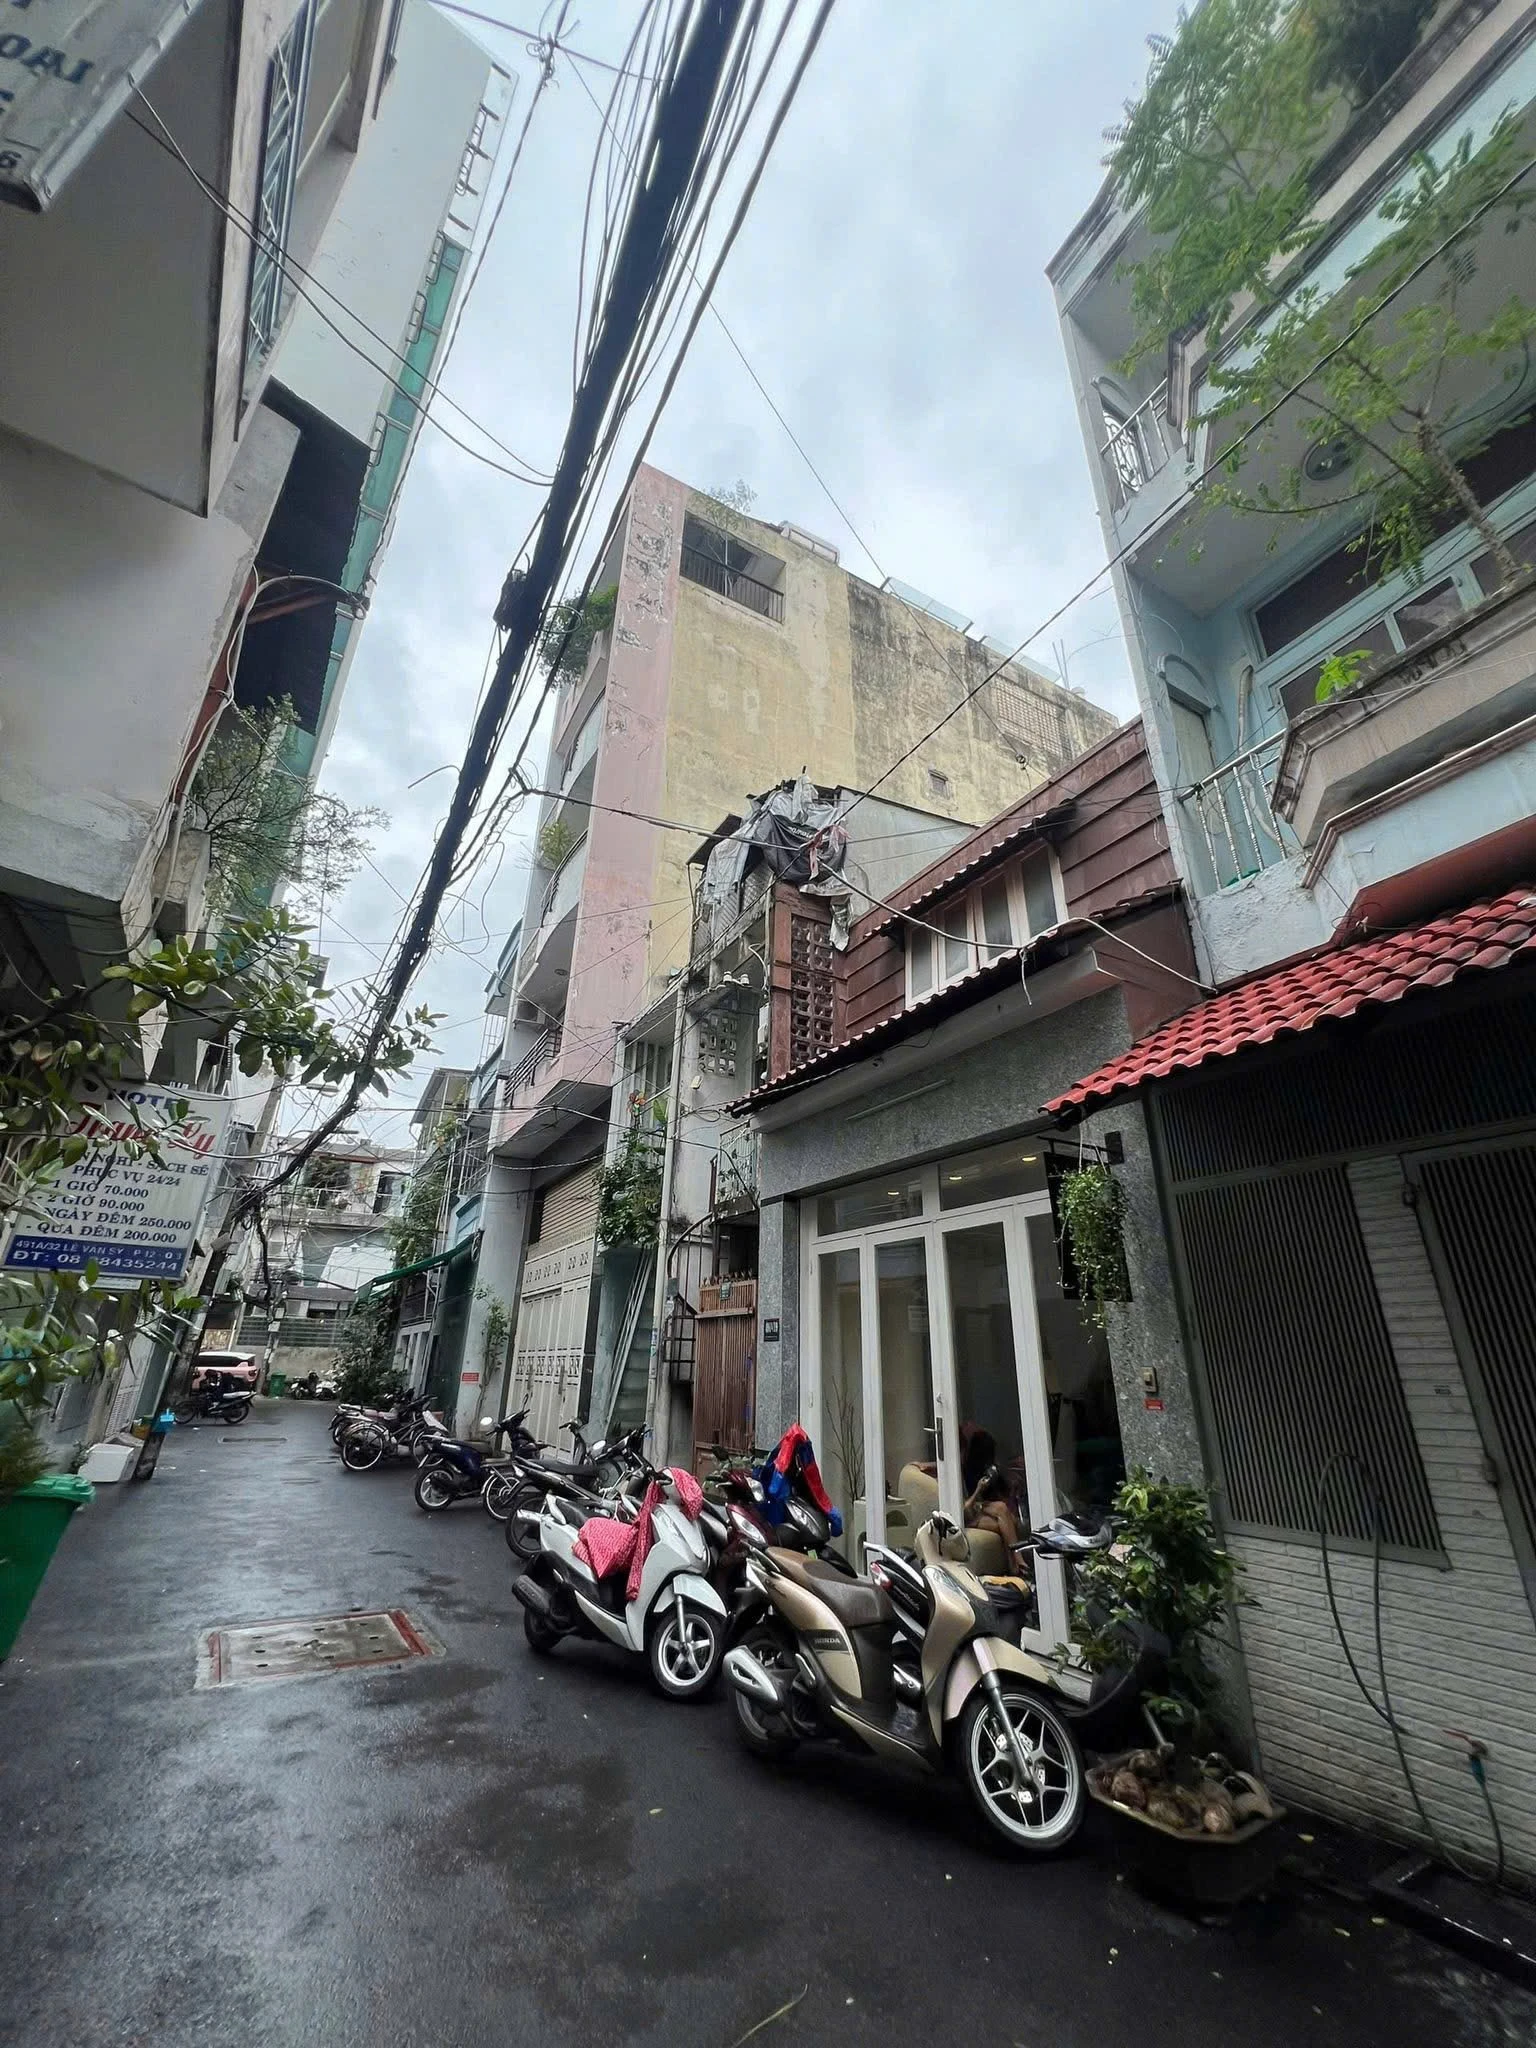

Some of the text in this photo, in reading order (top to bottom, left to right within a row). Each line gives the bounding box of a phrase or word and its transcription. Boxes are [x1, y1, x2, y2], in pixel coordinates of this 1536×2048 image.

[147, 1174, 181, 1186] 24/24
[104, 1185, 149, 1198] 70.000
[99, 1198, 145, 1212] 90.000
[96, 1210, 134, 1225] ĐÊM
[139, 1217, 192, 1231] 250.000
[80, 1224, 119, 1239] ĐÊM
[123, 1230, 177, 1243] 200.000
[57, 1253, 81, 1264] 08
[90, 1256, 178, 1271] 8435244
